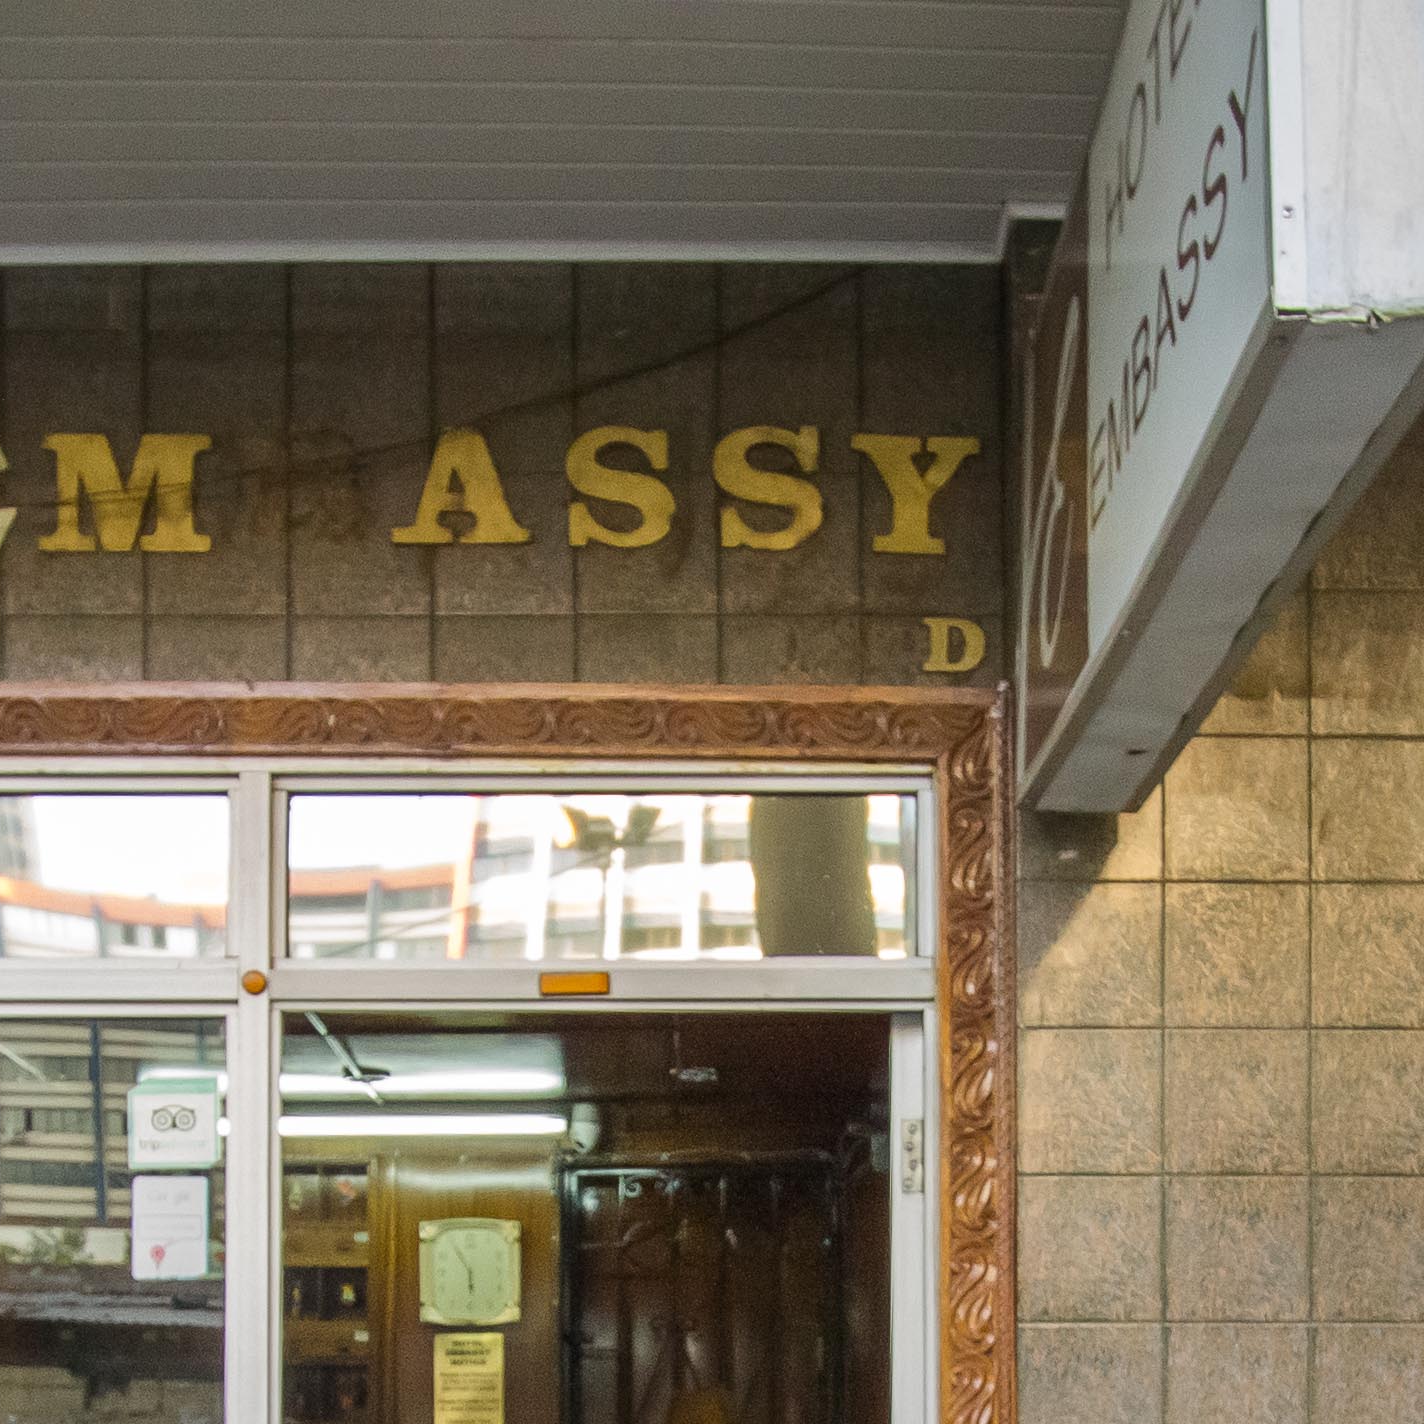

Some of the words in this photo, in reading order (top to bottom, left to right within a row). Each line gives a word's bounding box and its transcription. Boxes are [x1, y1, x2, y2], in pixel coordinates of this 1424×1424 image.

[1105, 0, 1201, 272] HOTE
[1091, 25, 1258, 531] EMBASSY
[922, 617, 987, 674] D
